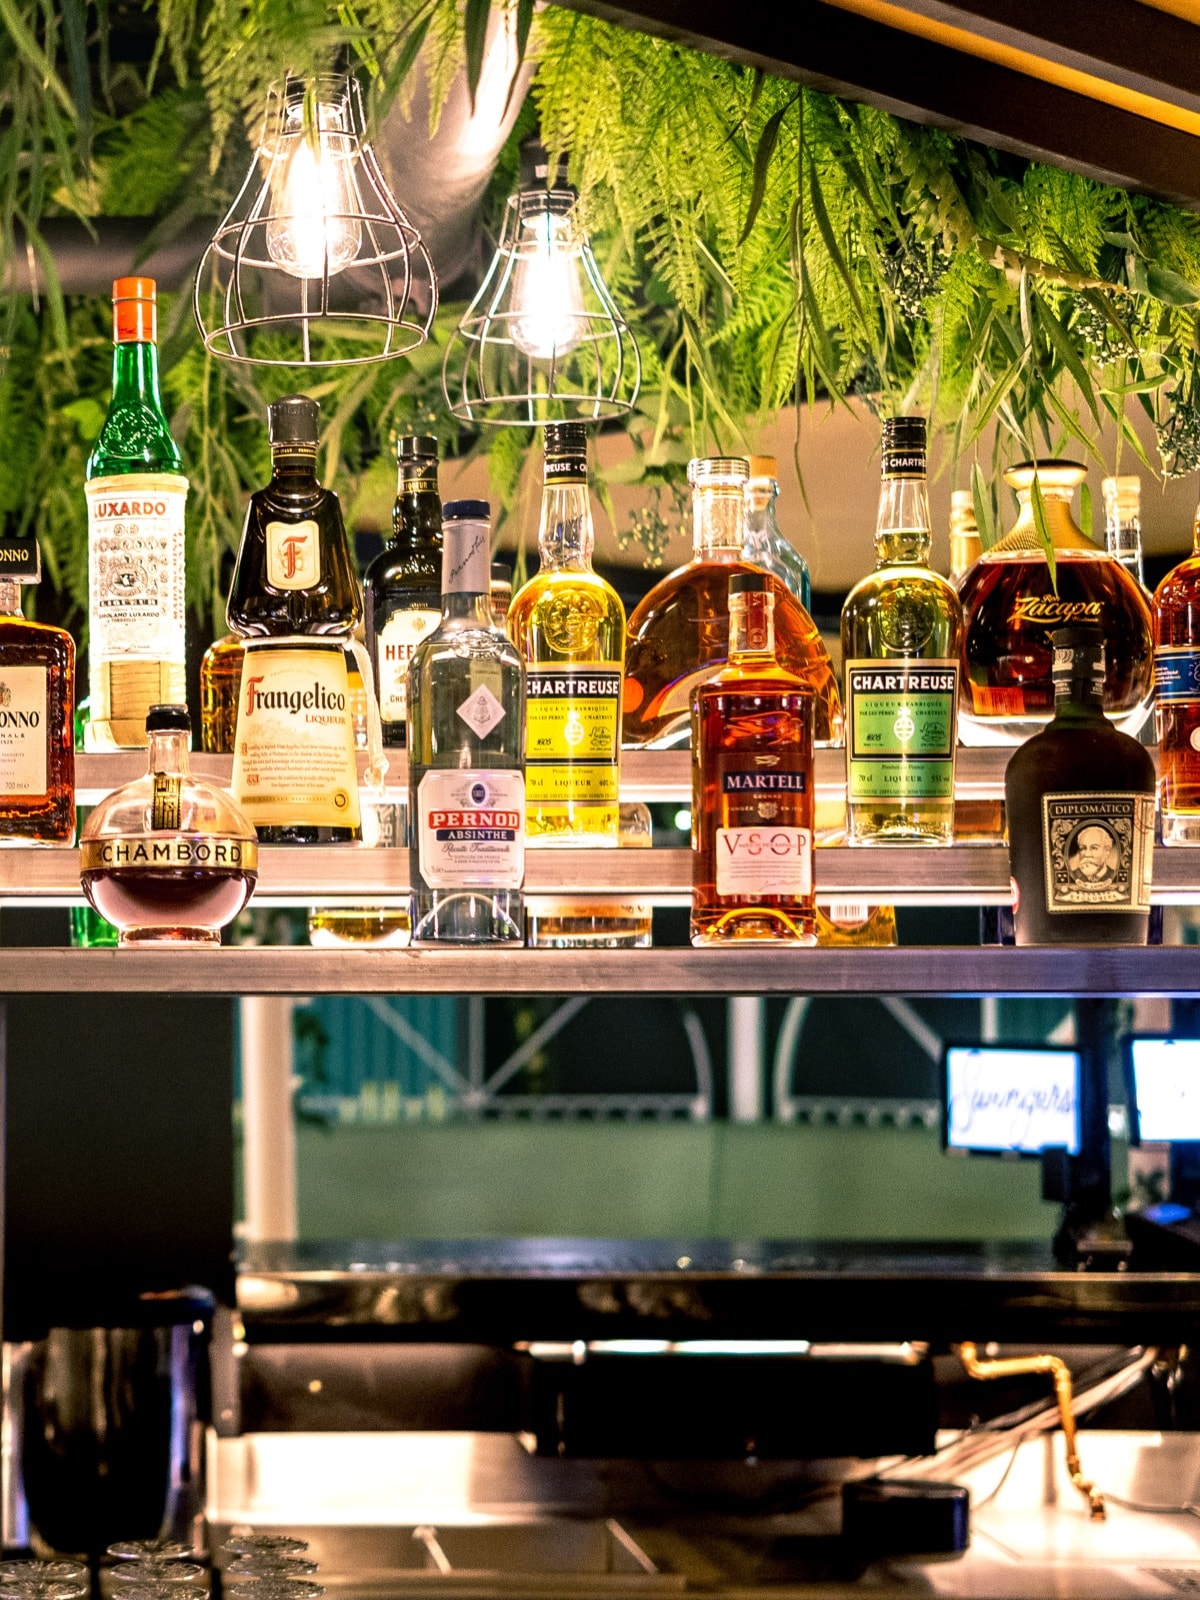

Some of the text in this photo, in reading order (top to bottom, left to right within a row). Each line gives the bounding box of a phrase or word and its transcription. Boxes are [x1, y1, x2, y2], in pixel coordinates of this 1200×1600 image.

[94, 501, 166, 518] LUXARDO
[853, 676, 954, 690] CHARTREUSE
[246, 676, 346, 717] Frangelico
[305, 714, 346, 726] LIQUEUR
[727, 775, 804, 790] MARTELL
[432, 812, 518, 827] PERNOD
[448, 830, 507, 840] ABSINTHE
[102, 844, 242, 862] CHAMBORD
